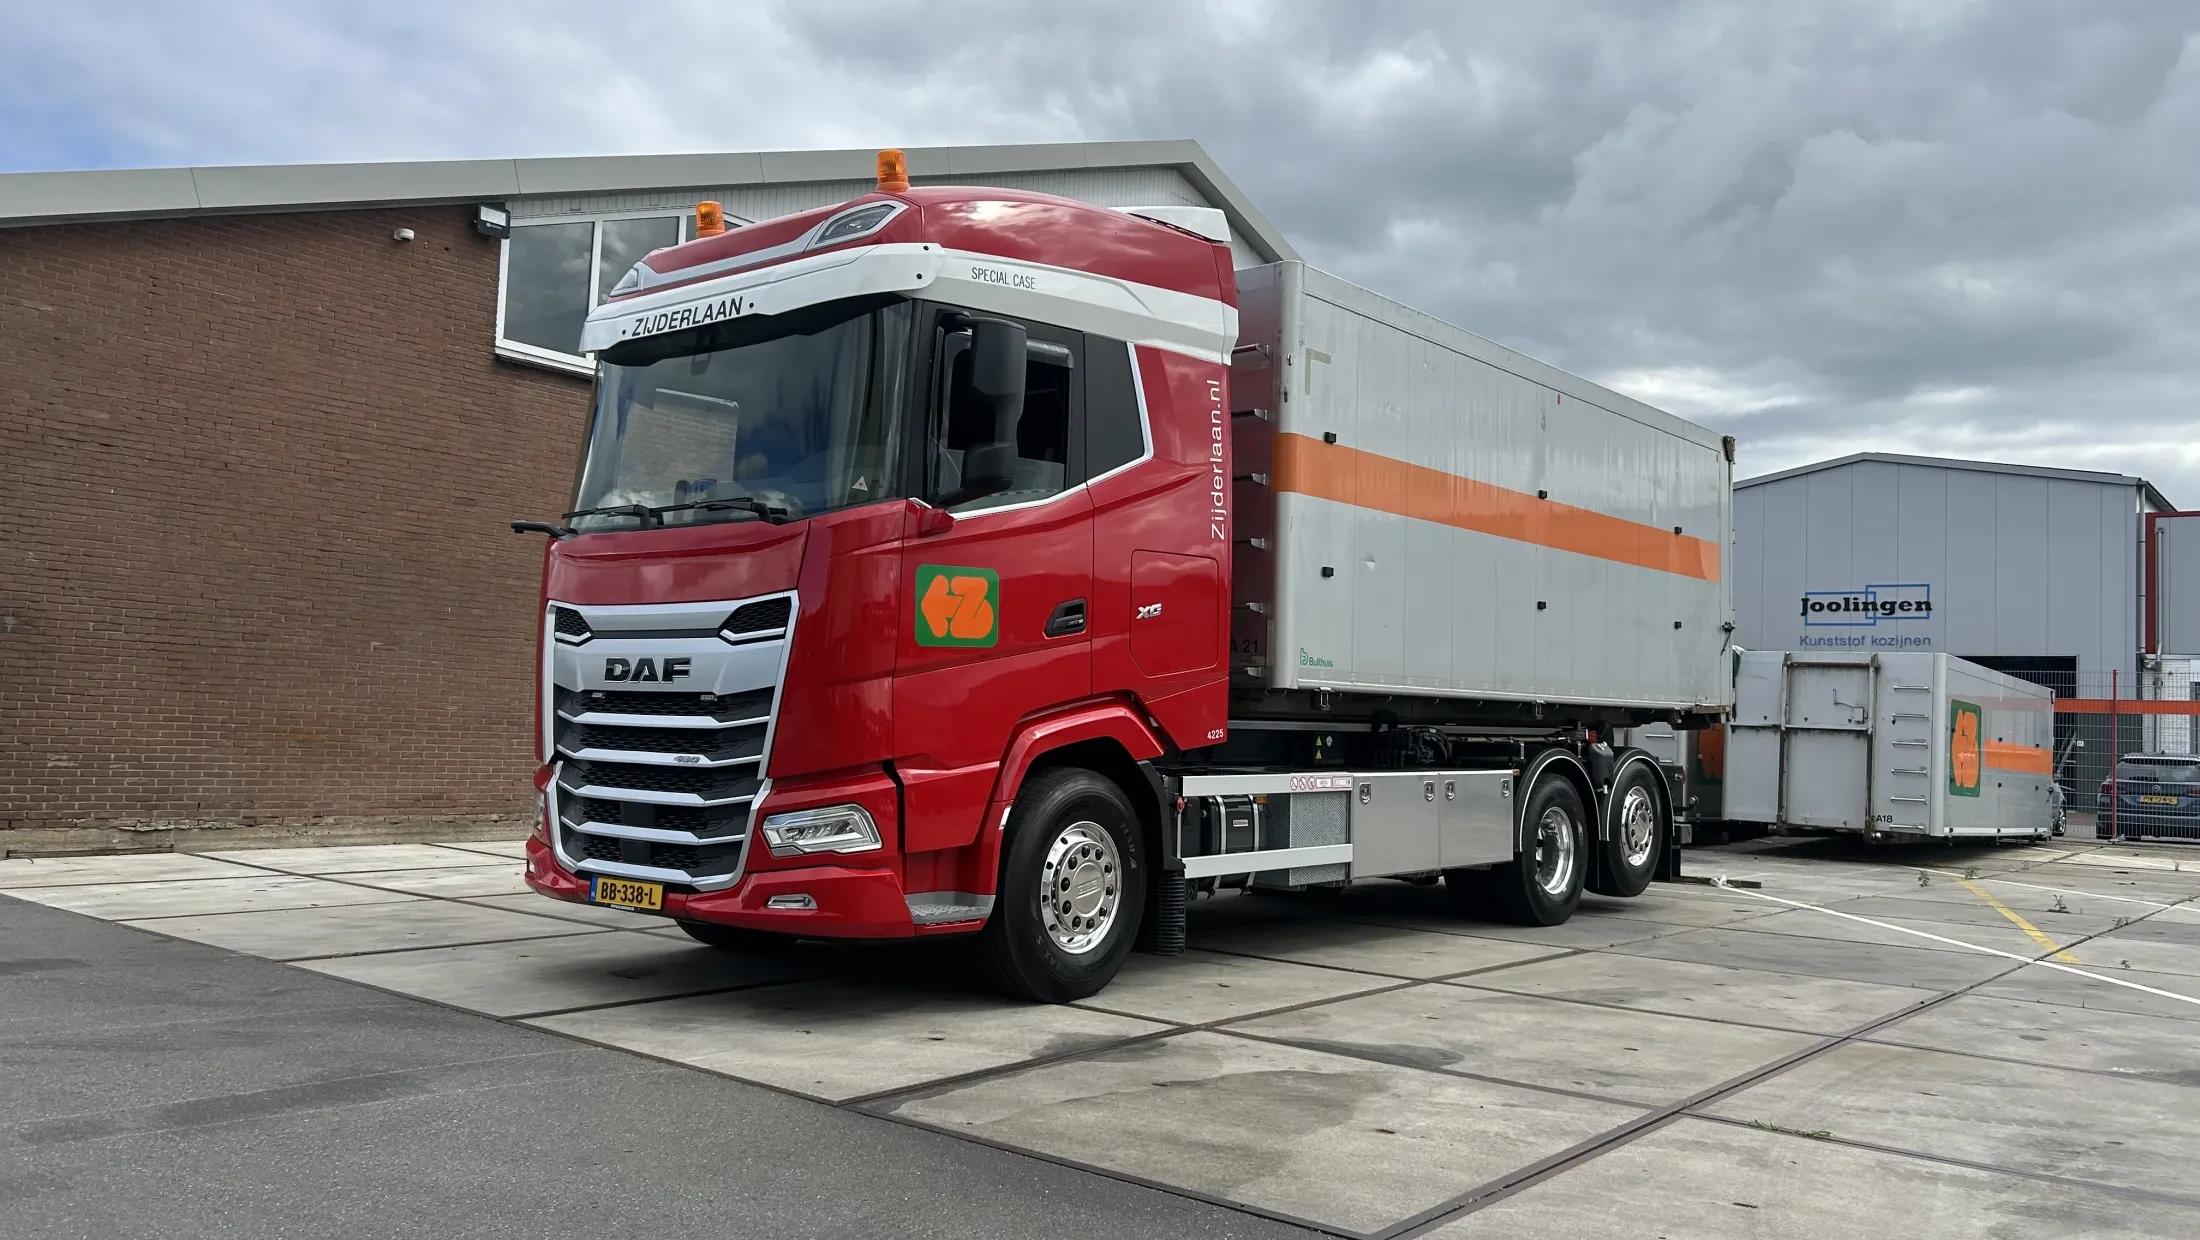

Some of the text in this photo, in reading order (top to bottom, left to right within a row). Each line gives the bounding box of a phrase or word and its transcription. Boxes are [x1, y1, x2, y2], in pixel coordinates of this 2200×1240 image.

[971, 266, 1036, 290] SPECIAL CASE
[631, 296, 744, 337] ZIJDERLAAN
[1206, 379, 1227, 541] Zijderlaan.nl
[1136, 603, 1162, 619] XG
[1800, 596, 1933, 617] Joolingen
[1242, 638, 1258, 653] 21
[1799, 635, 1932, 649] Kunststof kozijnen
[603, 656, 692, 684] DAF
[1308, 657, 1334, 668] Bulthuis
[1206, 728, 1224, 740] 4225
[1875, 814, 1893, 823] A18
[600, 881, 657, 906] BB-338-L
